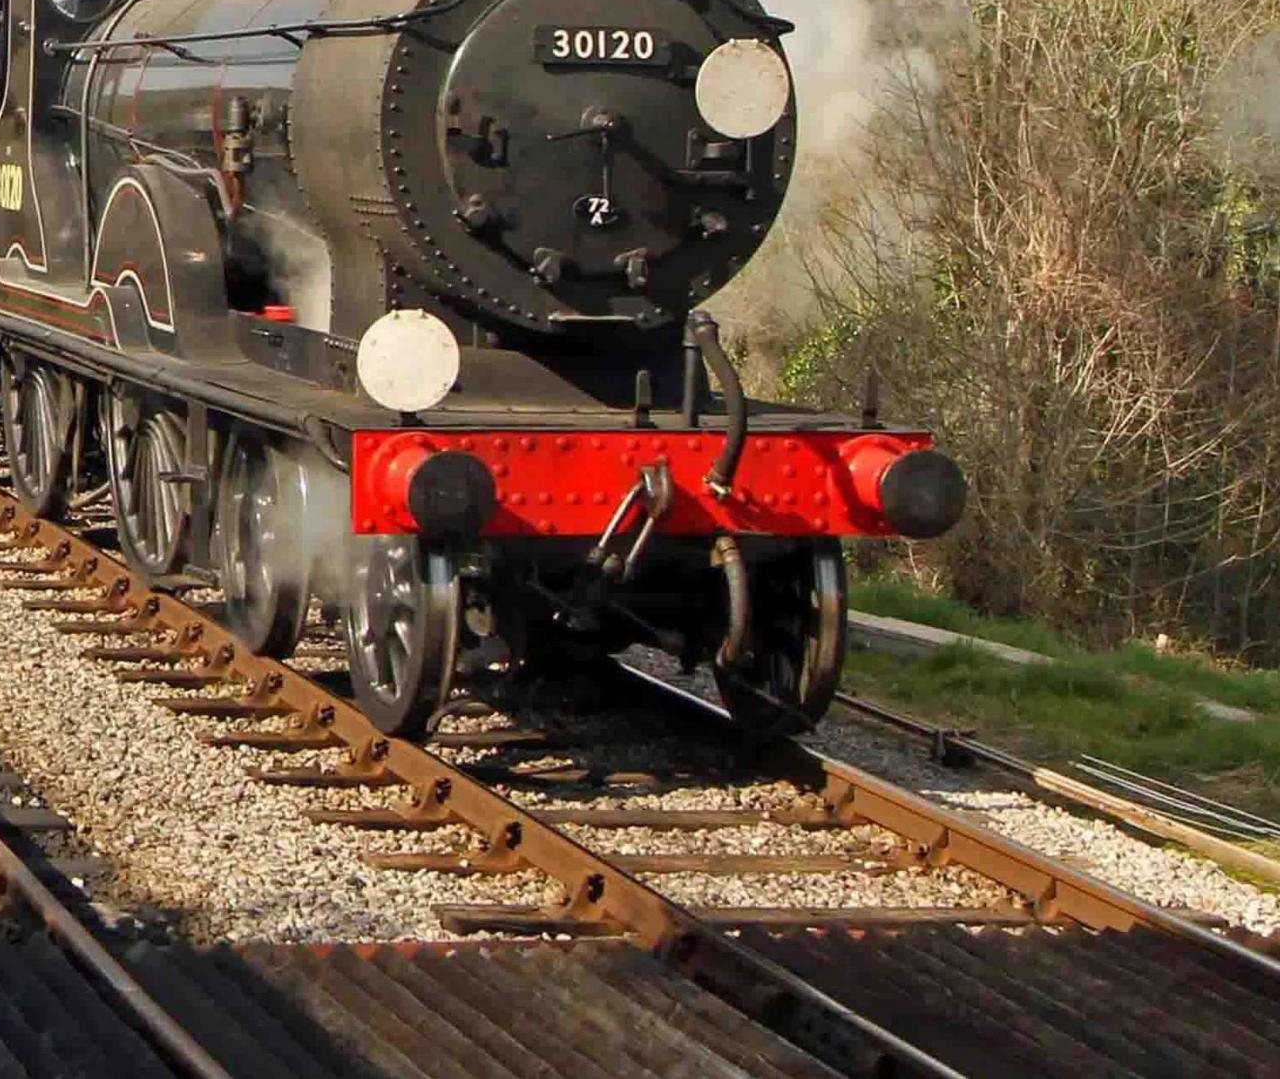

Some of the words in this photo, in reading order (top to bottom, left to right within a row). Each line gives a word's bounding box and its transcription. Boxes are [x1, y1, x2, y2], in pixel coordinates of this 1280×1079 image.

[552, 29, 653, 59] 30120
[589, 197, 609, 213] 72
[590, 211, 603, 225] A
